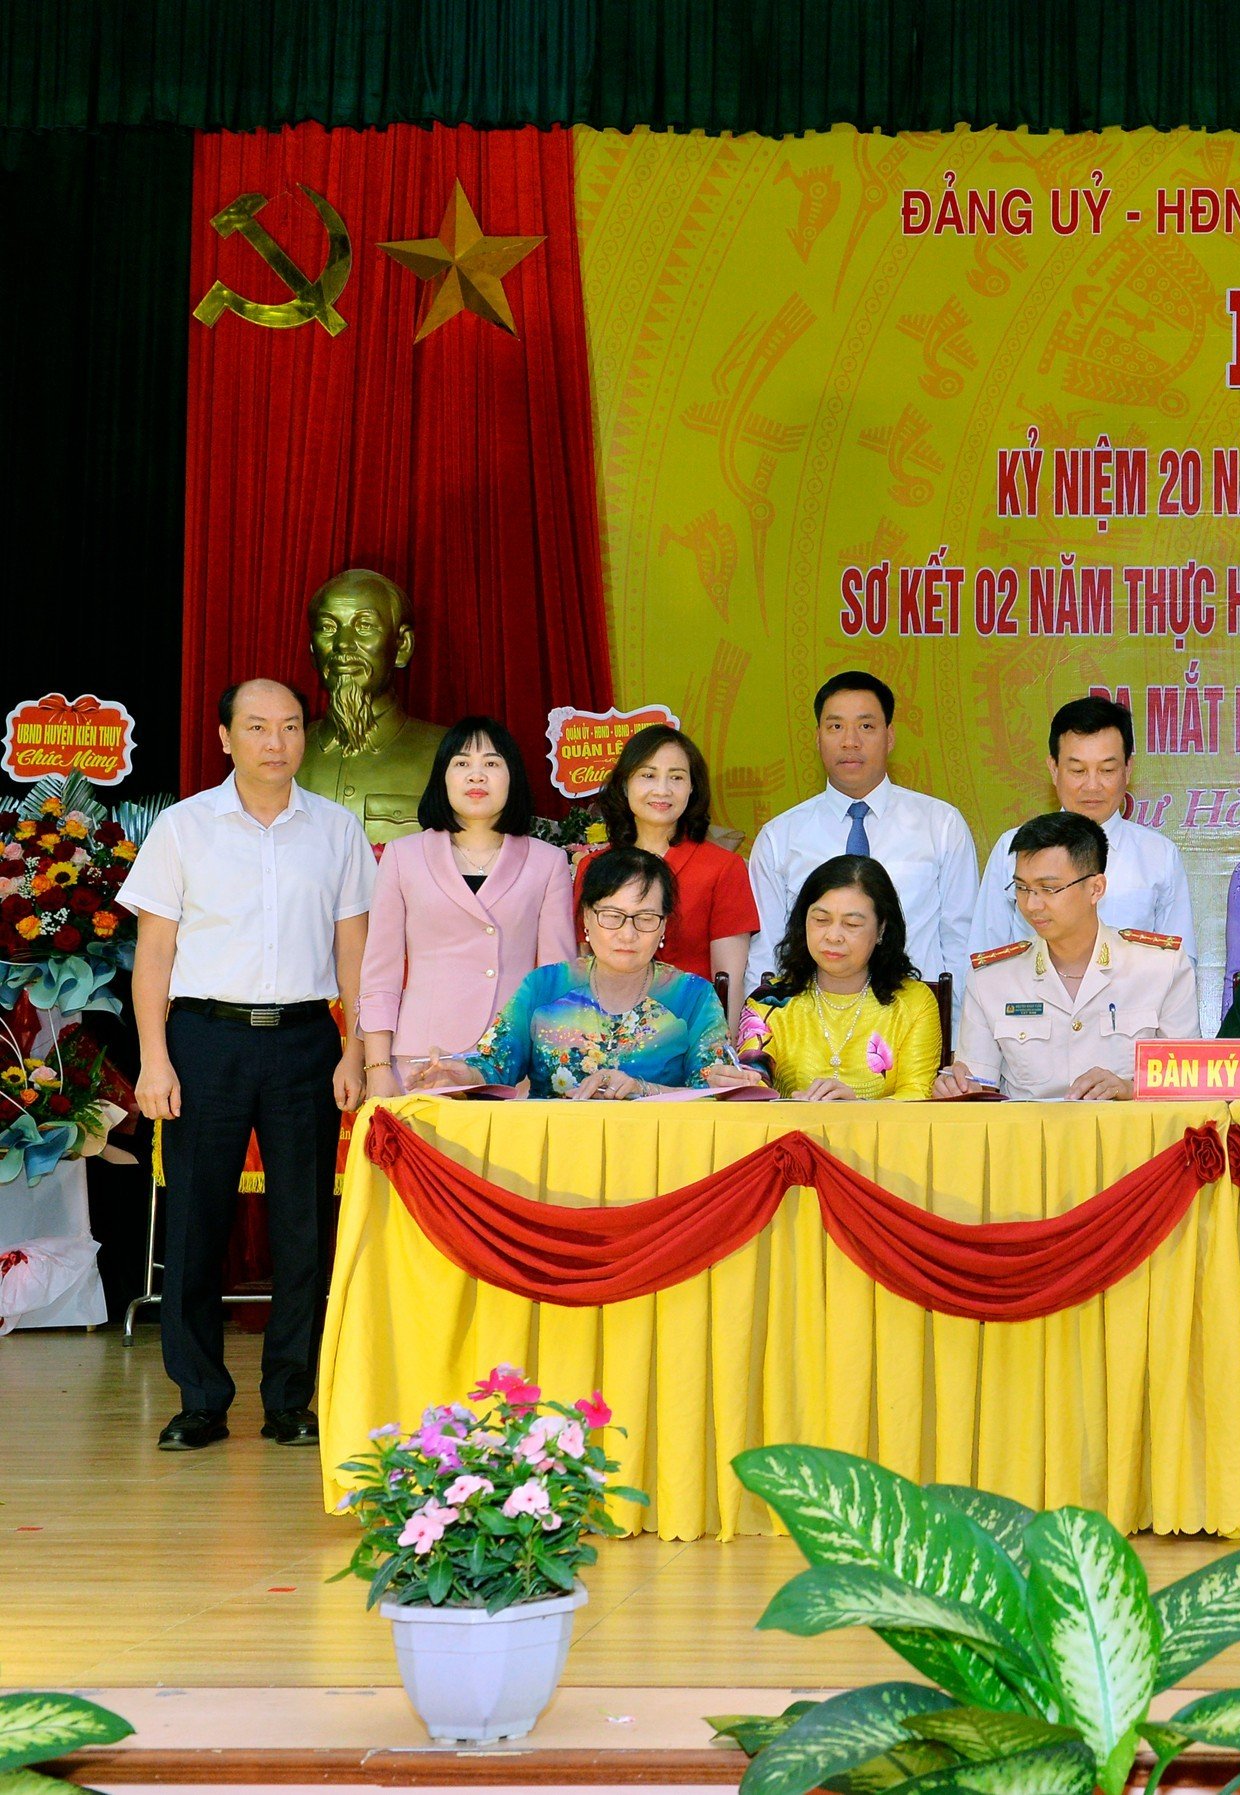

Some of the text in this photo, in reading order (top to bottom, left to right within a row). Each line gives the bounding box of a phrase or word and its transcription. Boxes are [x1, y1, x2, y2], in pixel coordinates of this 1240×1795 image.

[902, 170, 1033, 235] ĐẢNG
[1050, 170, 1112, 235] UỶ
[997, 425, 1044, 517] KỶ
[1053, 433, 1148, 533] NIỆM
[1157, 448, 1201, 517] 20
[839, 560, 890, 636] SƠ
[899, 545, 965, 636] KẾT
[974, 567, 1019, 636] 02
[1029, 552, 1113, 636] NĂM
[1123, 558, 1216, 650] THỰC
[1146, 659, 1224, 754] MẮT
[16, 748, 63, 766] Chúc
[17, 724, 42, 744] UBND
[44, 721, 74, 750] HUYỆN
[75, 719, 97, 746] KIẾN
[561, 740, 624, 759] QUẬN LÊ
[1146, 1052, 1199, 1088] BÀN
[1207, 1053, 1239, 1088] KÝ
